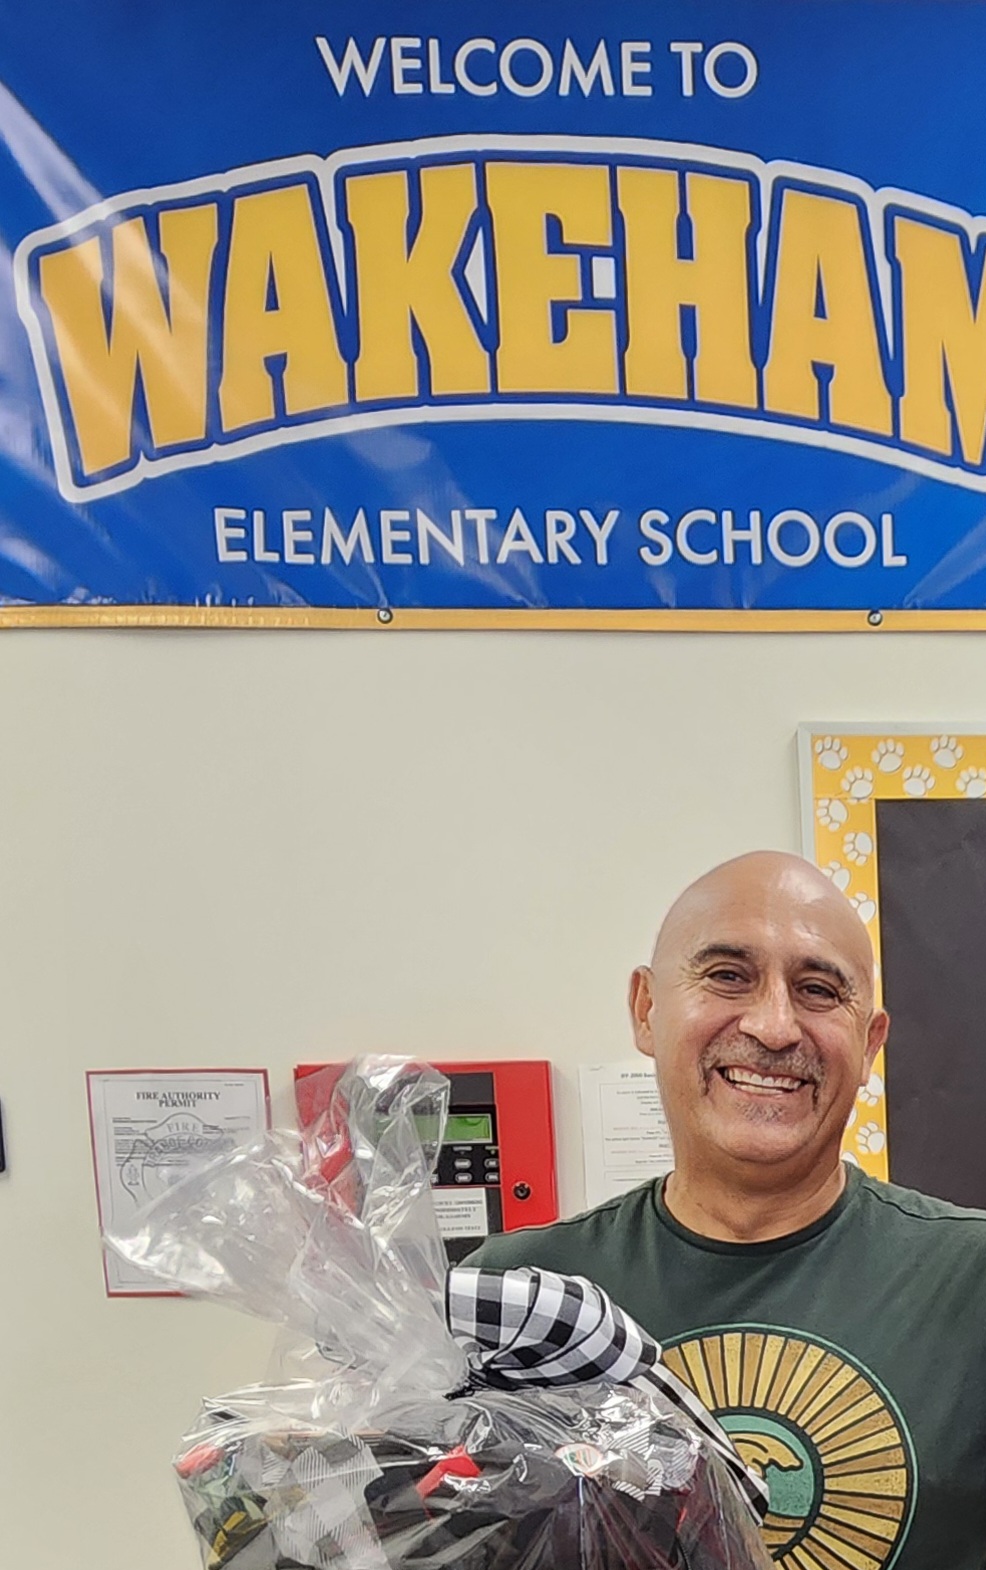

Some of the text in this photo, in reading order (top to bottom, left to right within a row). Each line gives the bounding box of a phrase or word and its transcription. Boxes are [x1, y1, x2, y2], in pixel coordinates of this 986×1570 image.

[316, 36, 759, 97] WELCOME TO
[212, 506, 907, 568] ELEMENTARY SCHOOL
[136, 1091, 220, 1100] FIRE AUTHORITY
[158, 1099, 196, 1108] PERMIT
